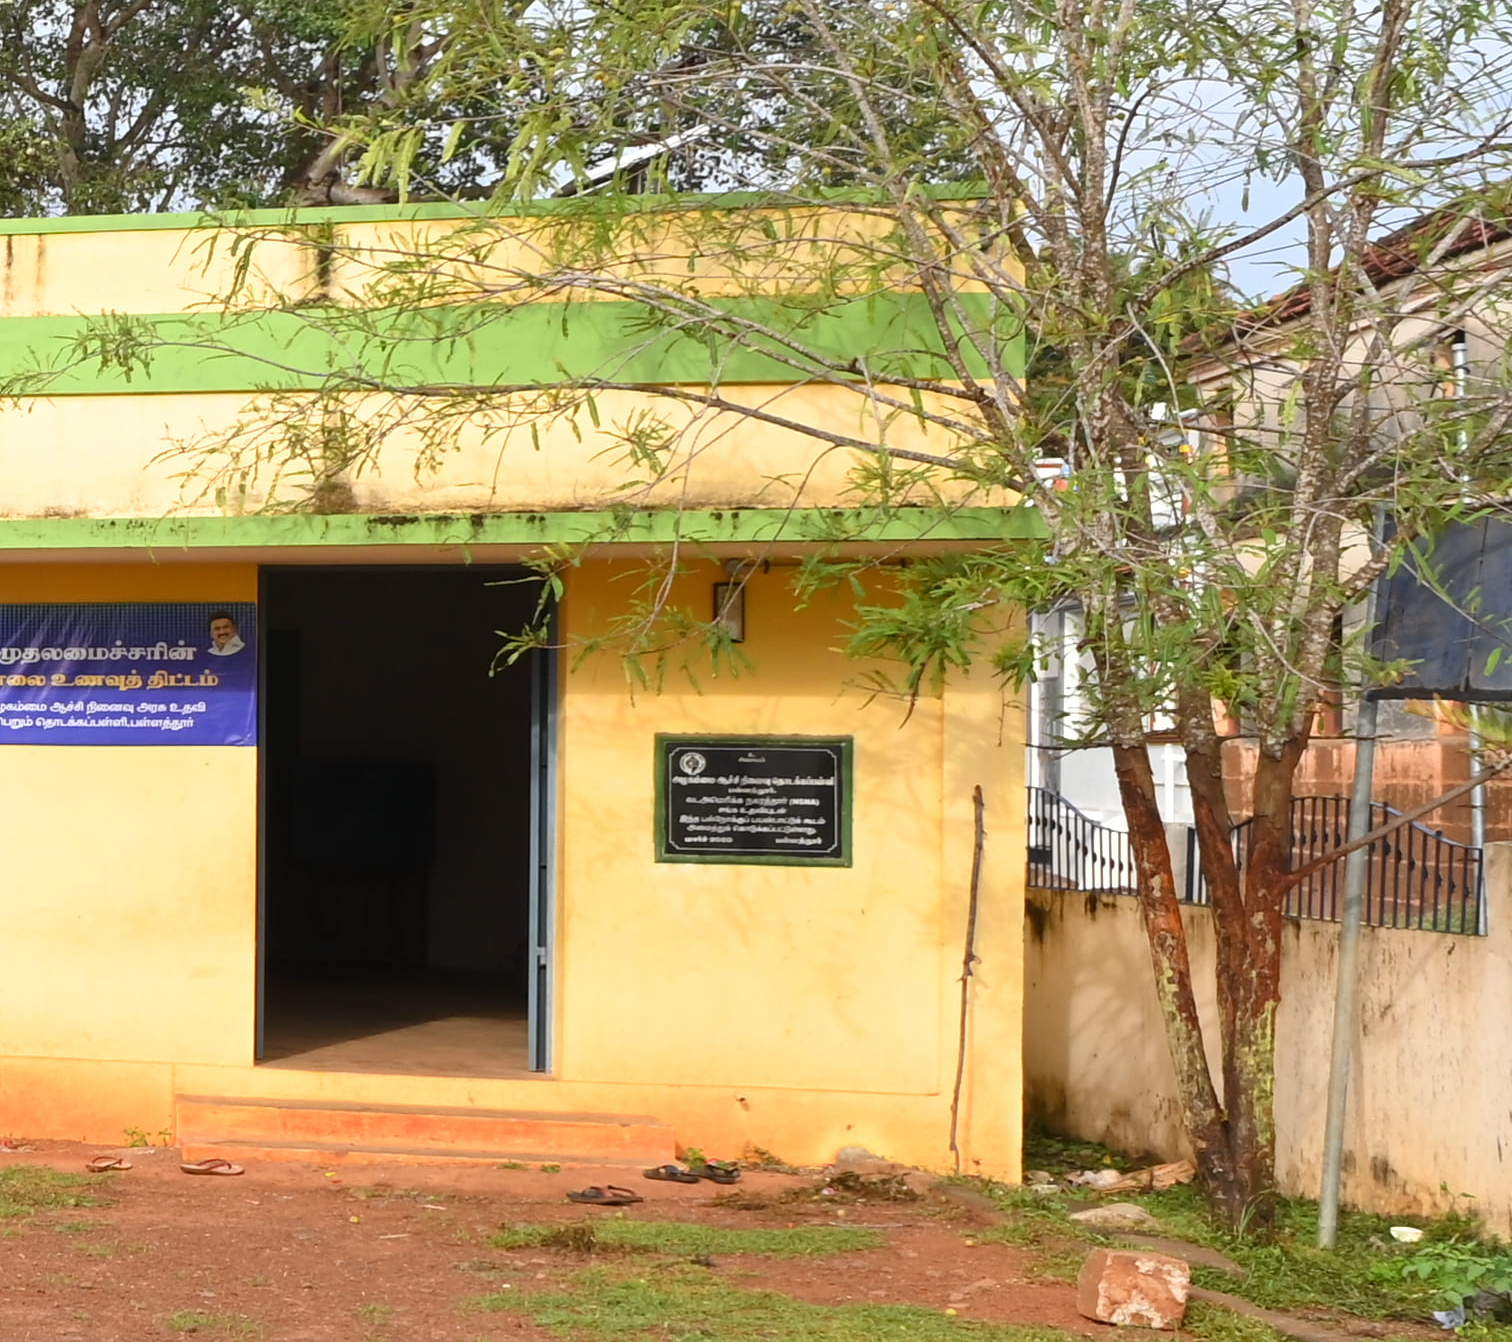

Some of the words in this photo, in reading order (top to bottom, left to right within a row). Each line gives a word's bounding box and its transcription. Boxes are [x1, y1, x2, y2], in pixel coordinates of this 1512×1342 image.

[51, 669, 143, 691] உணவுத்
[147, 668, 219, 690] திட்டம்
[49, 700, 84, 713] ஆச்சி
[86, 700, 134, 715] நினைவு
[136, 702, 167, 713] அரசு
[169, 701, 206, 715] உதவி
